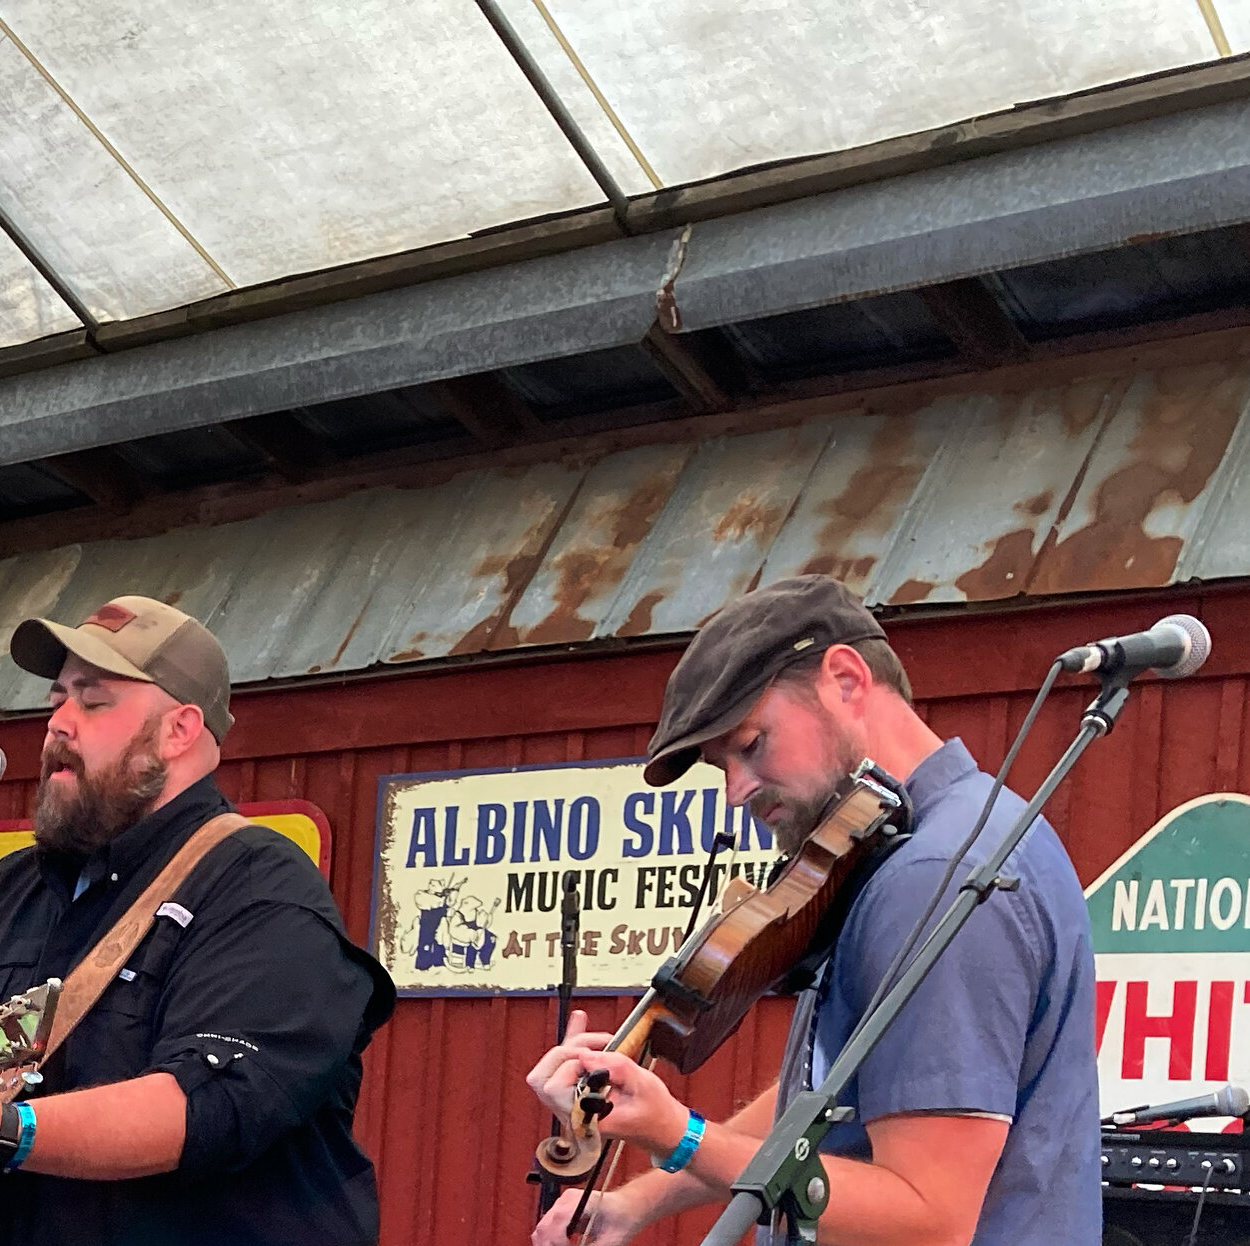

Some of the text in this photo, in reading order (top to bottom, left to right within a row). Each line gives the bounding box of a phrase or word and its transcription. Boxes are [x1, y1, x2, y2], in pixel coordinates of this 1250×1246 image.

[406, 788, 773, 868] ALBINO SKUN
[635, 862, 767, 909] FESTV
[1112, 877, 1250, 931] NATIO
[502, 924, 686, 958] AT TE SKU
[1095, 980, 1250, 1082] HI
